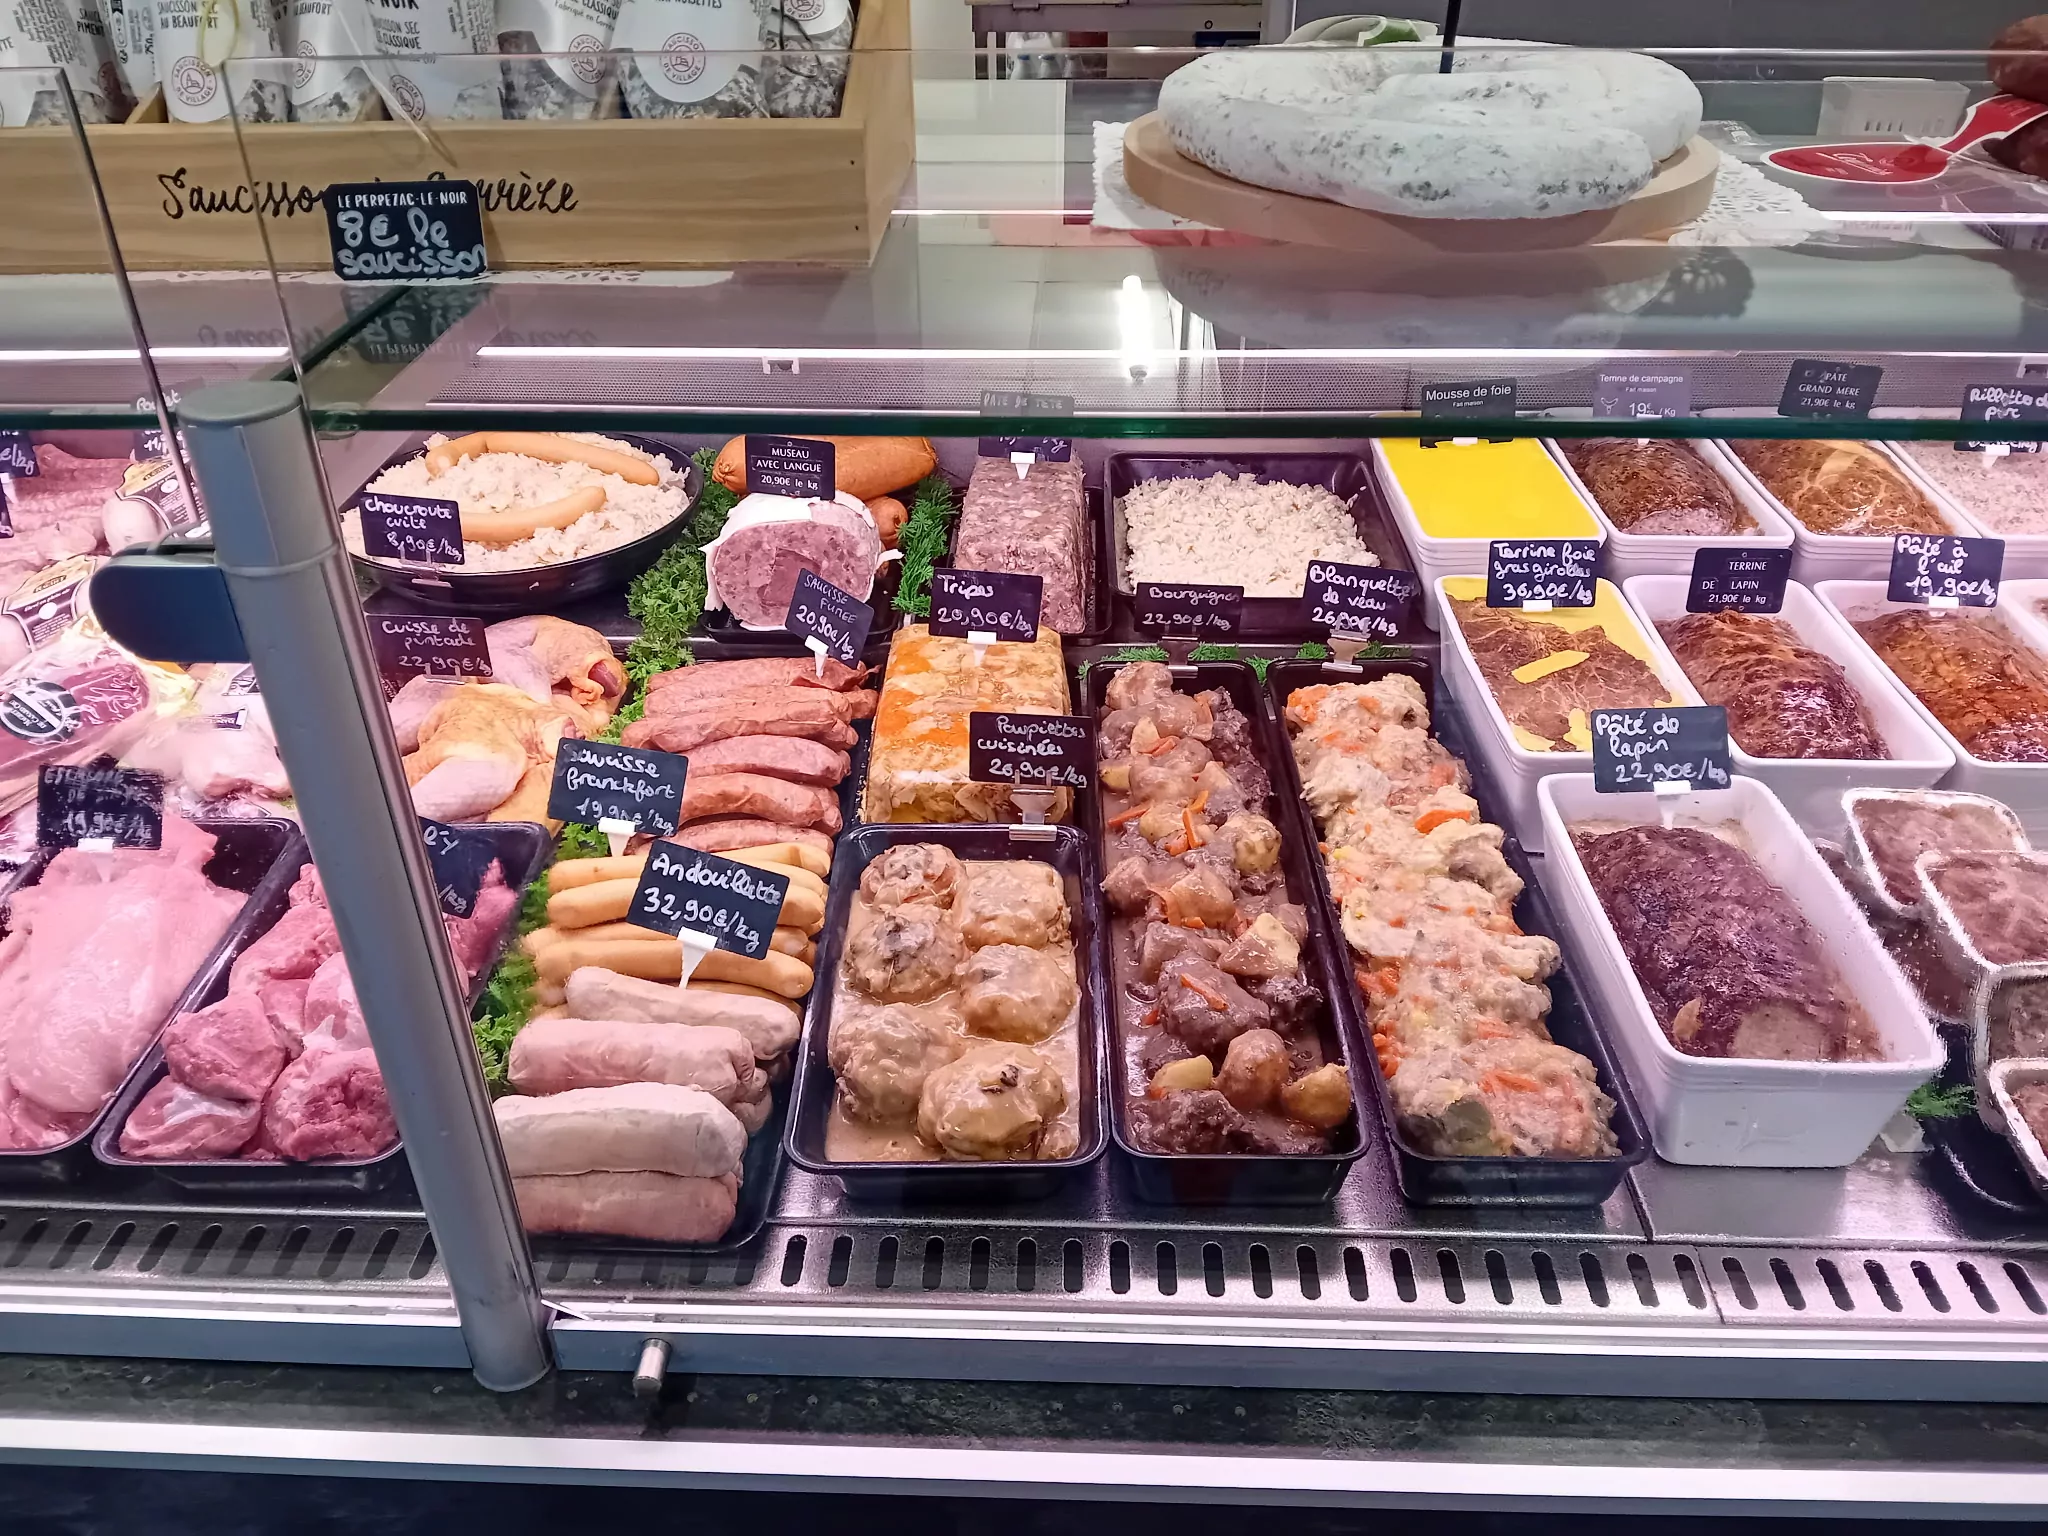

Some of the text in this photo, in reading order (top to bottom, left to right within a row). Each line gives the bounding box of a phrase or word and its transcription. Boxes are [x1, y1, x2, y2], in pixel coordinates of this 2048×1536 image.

[172, 15, 218, 29] BEAUFRT
[157, 167, 324, 219] Saucisso
[338, 195, 350, 208] LE
[406, 207, 449, 248] le
[336, 244, 487, 277] saucisson
[1629, 374, 1640, 383] de
[1641, 375, 1684, 385] campagne
[1426, 384, 1512, 401] Mousse de foie
[1798, 384, 1833, 394] GRAND
[1833, 400, 1842, 408] le
[1845, 401, 1856, 410] kg
[771, 447, 809, 459] MUSEAU
[756, 459, 822, 472] AVEC LANGUE
[761, 474, 818, 490] 20,90€ le kg
[386, 516, 427, 529] cuite
[1493, 542, 1596, 566] Terrine foie
[1952, 539, 1969, 558] à
[1728, 561, 1768, 571] TERRINE
[1702, 580, 1760, 590] DE LAPIN
[1347, 596, 1386, 611] veau
[1743, 594, 1751, 603] le
[1755, 594, 1767, 605] kg
[382, 617, 471, 635] Cuisse de
[1595, 711, 1680, 736] Pâté de
[1609, 735, 1669, 761] lapin
[643, 887, 760, 954] 32,90€/kg
